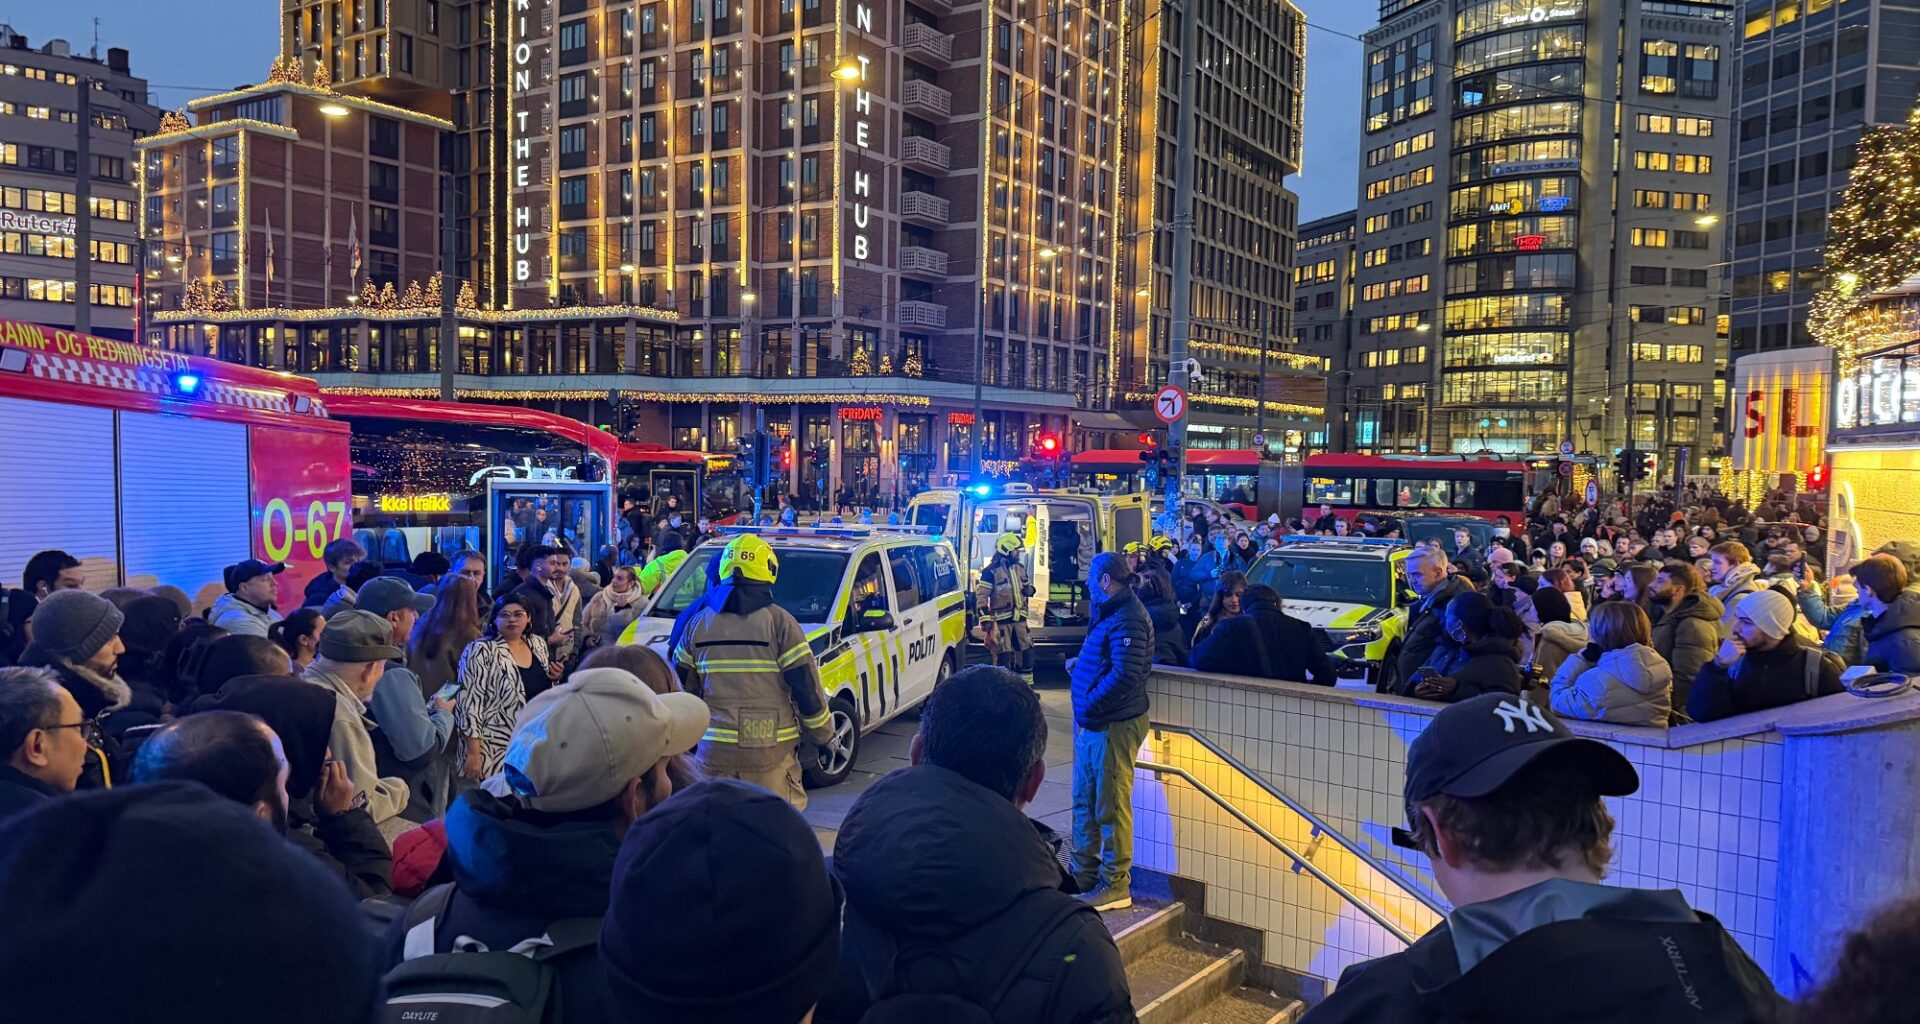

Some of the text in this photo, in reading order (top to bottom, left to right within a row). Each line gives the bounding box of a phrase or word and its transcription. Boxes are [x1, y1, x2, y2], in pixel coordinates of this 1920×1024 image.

[856, 55, 870, 148] THE
[516, 112, 529, 186] THE
[854, 170, 869, 260] HUB
[516, 206, 529, 280] HUB
[1513, 235, 1547, 246] THON
[55, 331, 83, 356] OG
[87, 336, 190, 373] REDNINGSETAT
[414, 497, 450, 511] trafikk
[741, 551, 755, 561] 69
[908, 633, 936, 665] POLITI
[1493, 699, 1554, 733] NY
[402, 1011, 439, 1021] DAYLITE
